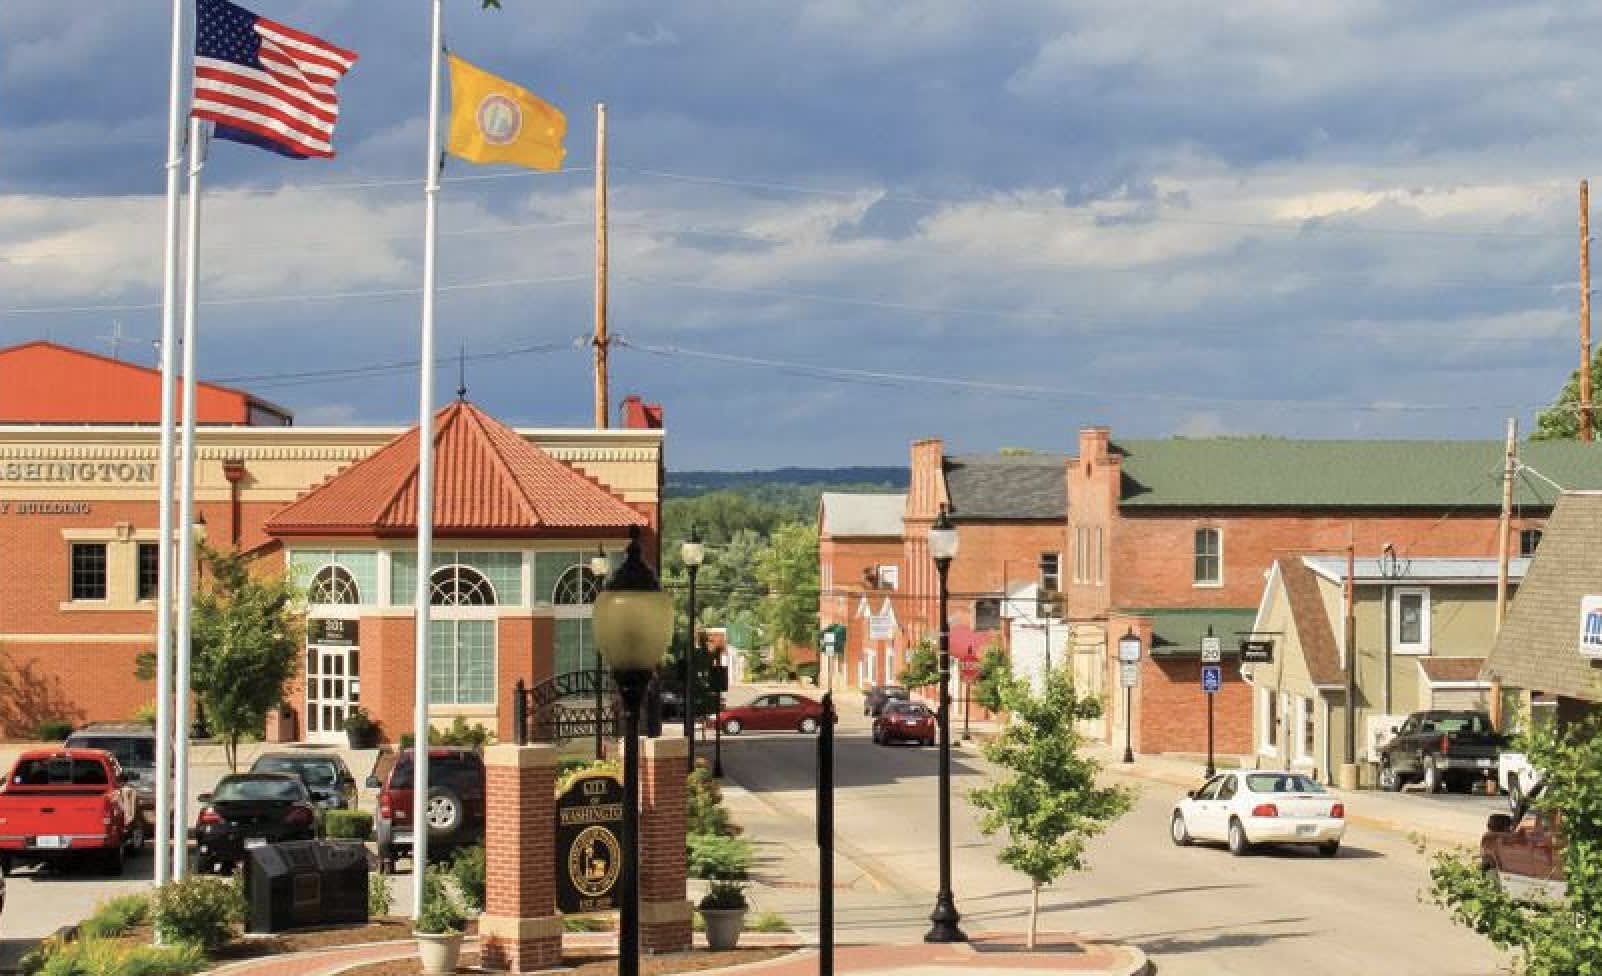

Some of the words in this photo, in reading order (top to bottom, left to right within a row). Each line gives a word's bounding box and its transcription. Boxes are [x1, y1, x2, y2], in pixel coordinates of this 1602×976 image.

[0, 462, 156, 483] SHINGTON
[16, 502, 90, 515] BUILDING
[559, 803, 624, 826] WASHINGTO
